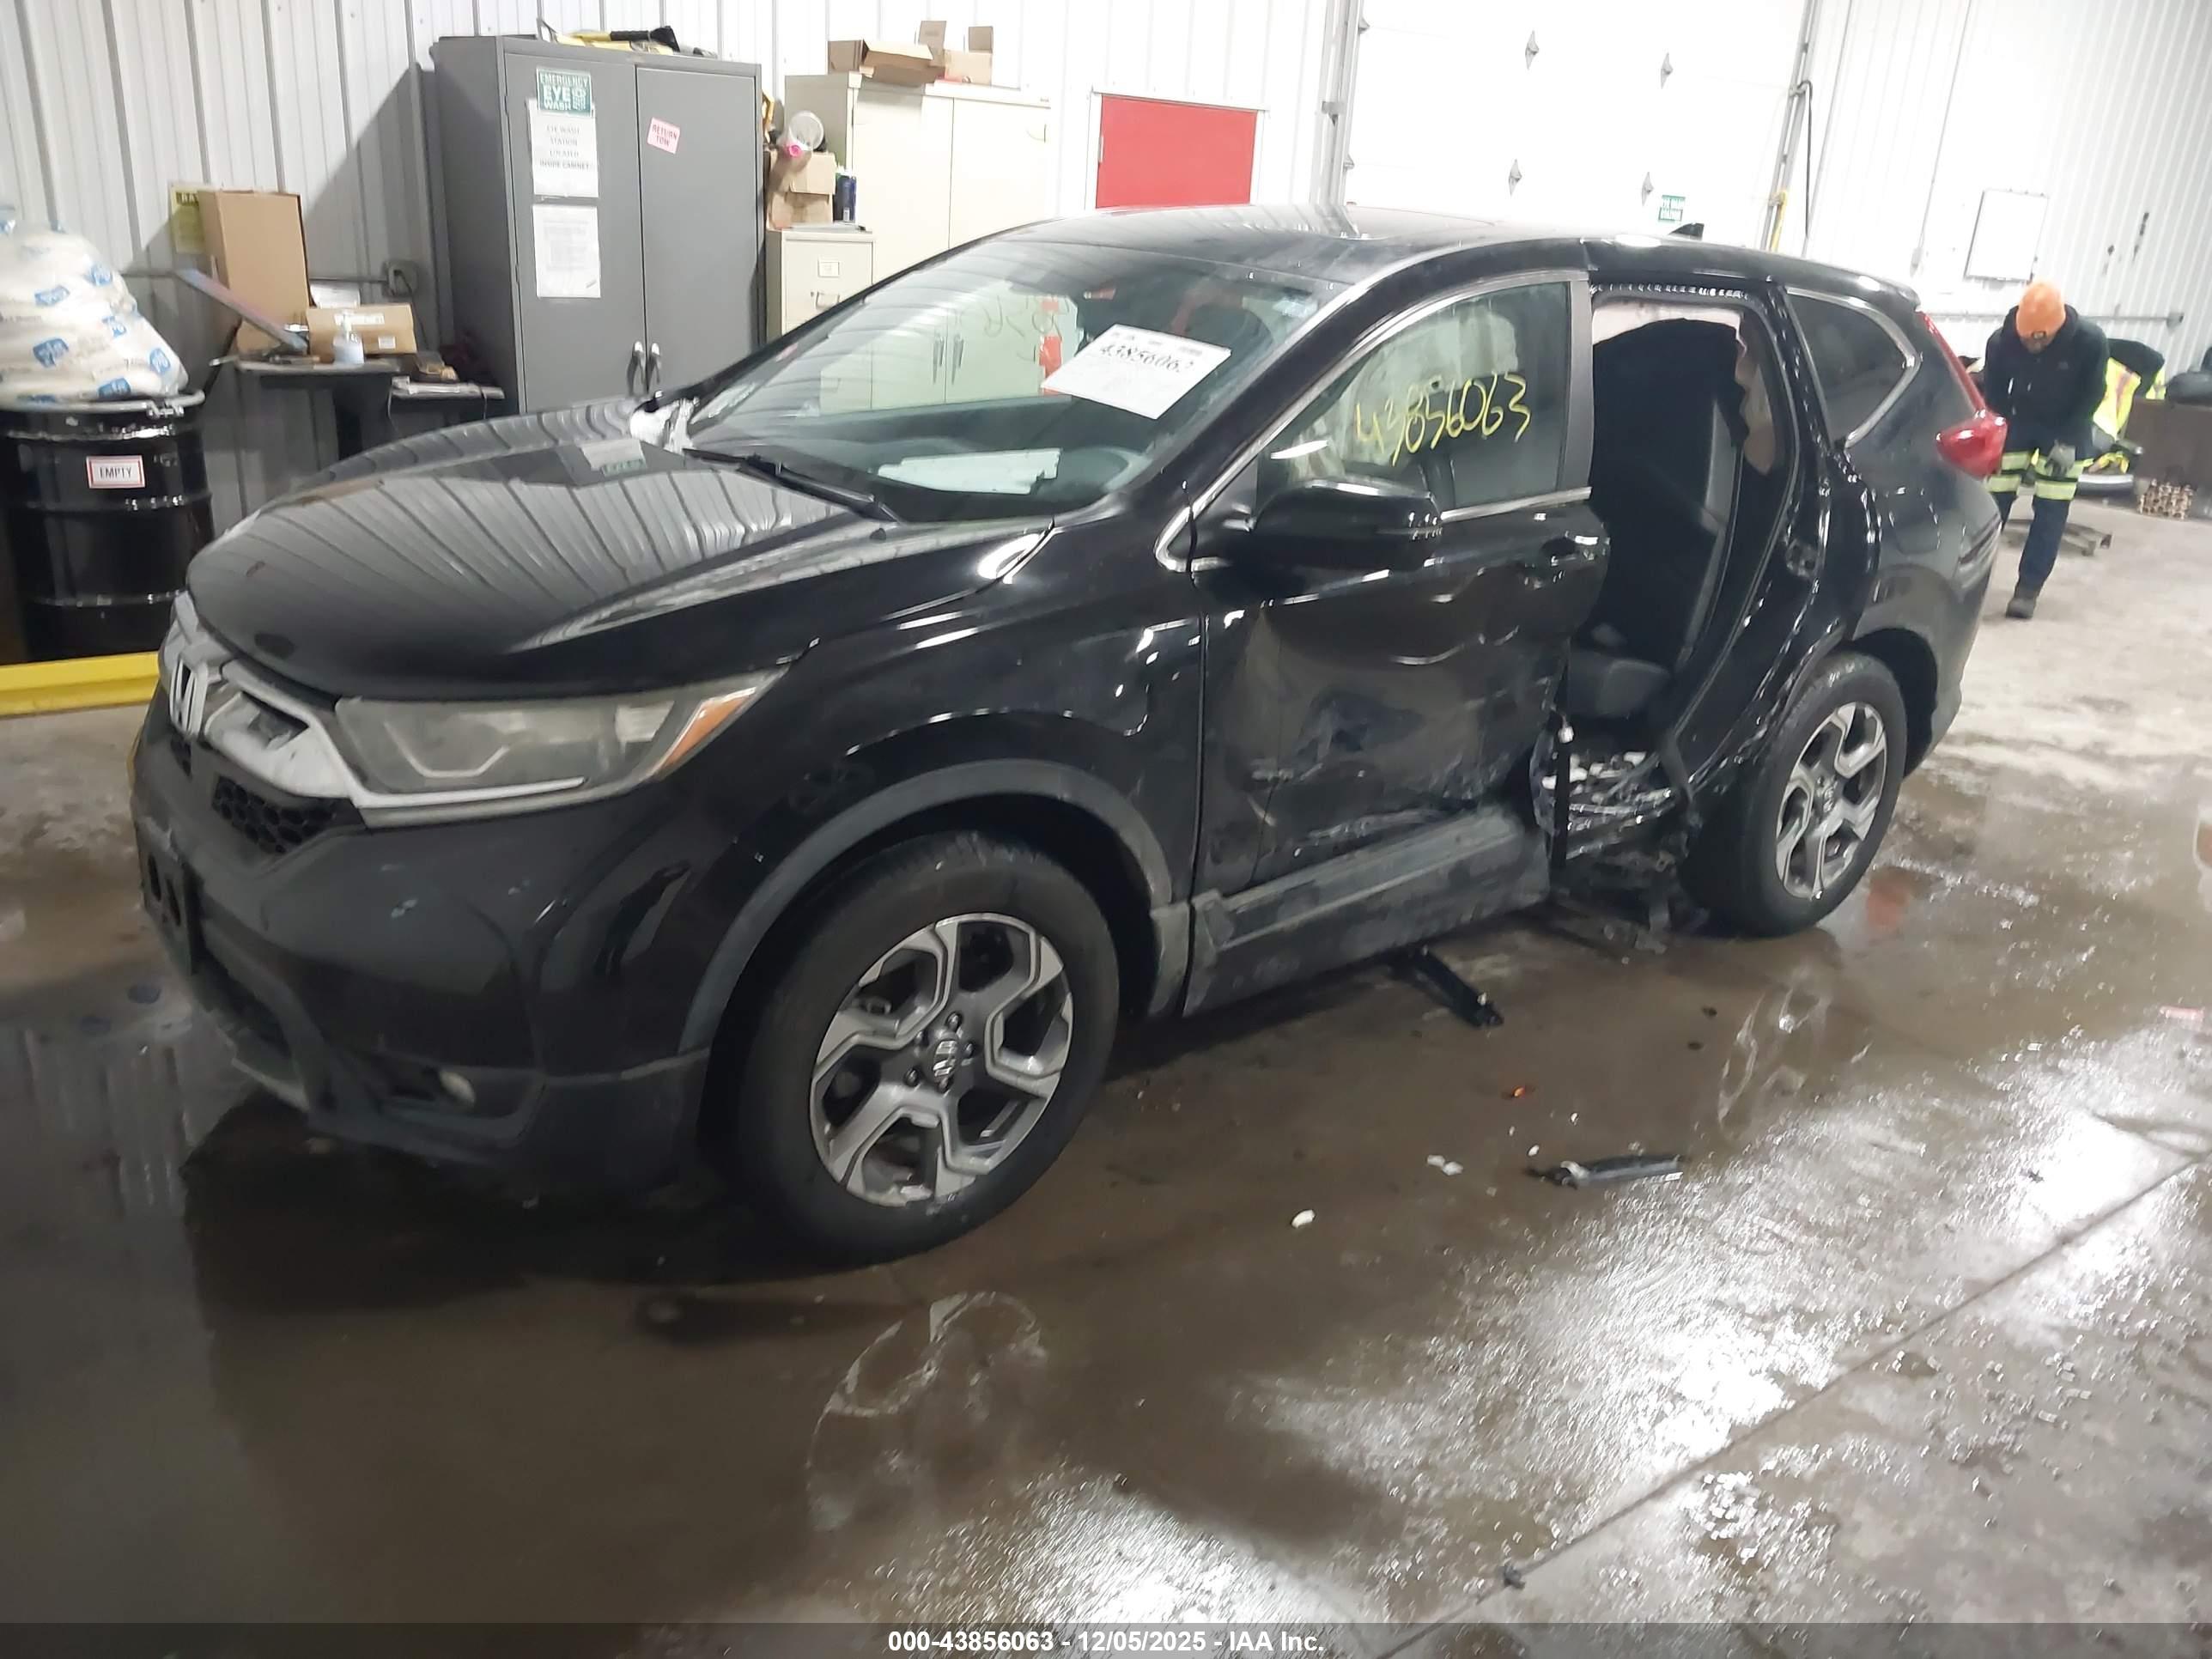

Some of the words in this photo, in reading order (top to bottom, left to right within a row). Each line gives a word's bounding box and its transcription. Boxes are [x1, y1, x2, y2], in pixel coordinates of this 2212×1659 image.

[540, 72, 588, 87] EMERGENCY
[543, 84, 571, 102] EYE
[544, 99, 572, 111] WASH
[652, 124, 678, 140] RETURN
[656, 135, 670, 147] TOW
[100, 466, 131, 479] EMPTY
